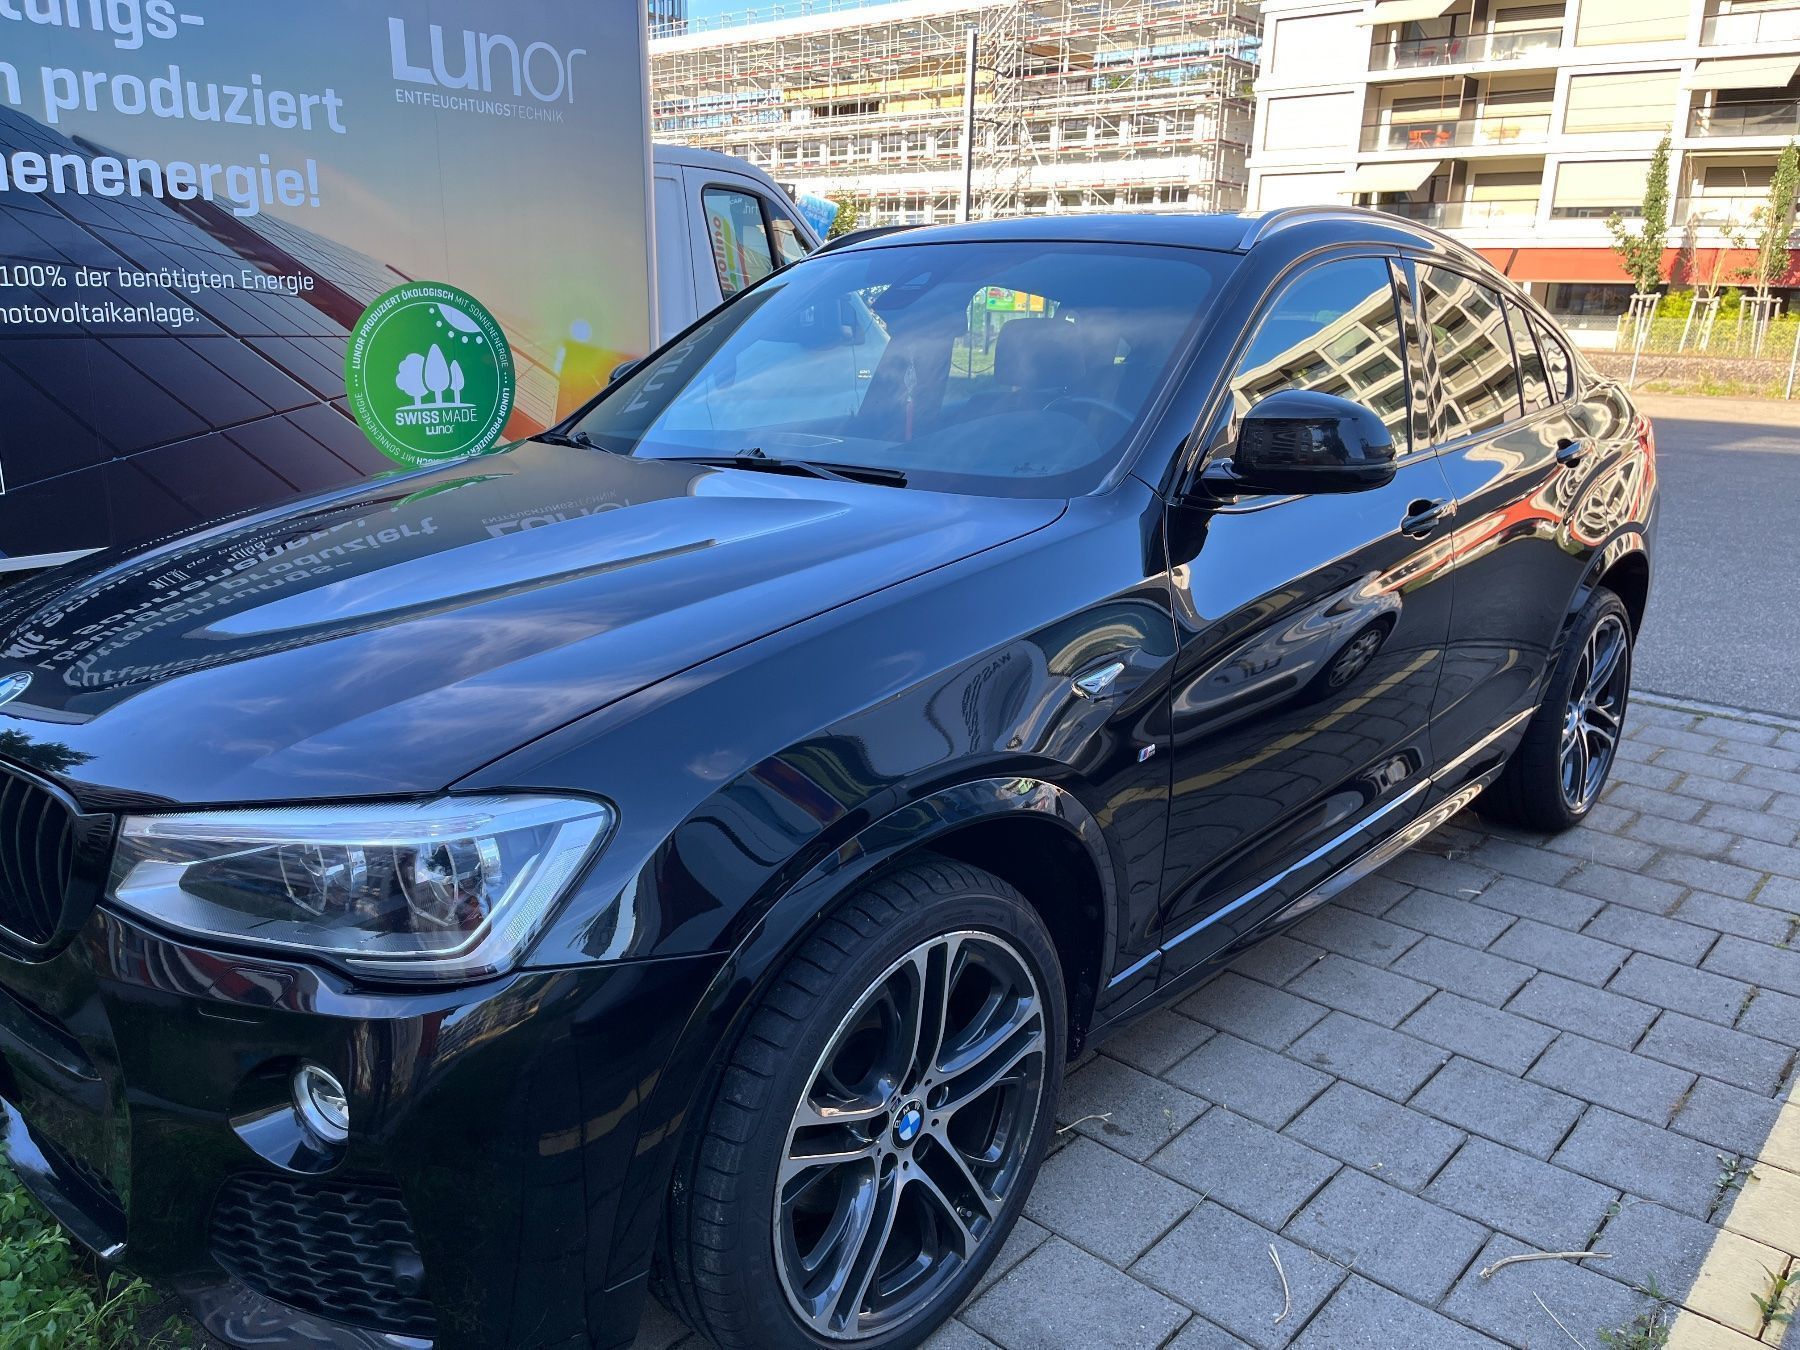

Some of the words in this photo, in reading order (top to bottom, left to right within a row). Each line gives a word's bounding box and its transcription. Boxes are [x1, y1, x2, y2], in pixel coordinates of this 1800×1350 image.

[41, 65, 347, 134] produziert
[395, 89, 565, 123] ENTFEUCHTUNGSTECHNIK
[75, 265, 111, 287] der
[118, 266, 235, 294] benötigten
[241, 269, 314, 295] Energie
[352, 336, 366, 369] LUNOR
[360, 293, 401, 338] PRODUZIERT
[401, 287, 454, 301] ÖKOLOGISCH
[455, 295, 470, 308] MIT
[468, 304, 509, 368] SONNENENERGIE
[395, 410, 440, 426] SWISS
[442, 408, 478, 424] MADE
[498, 387, 510, 418] LUNOR
[354, 391, 401, 456] SONNENENERGIE
